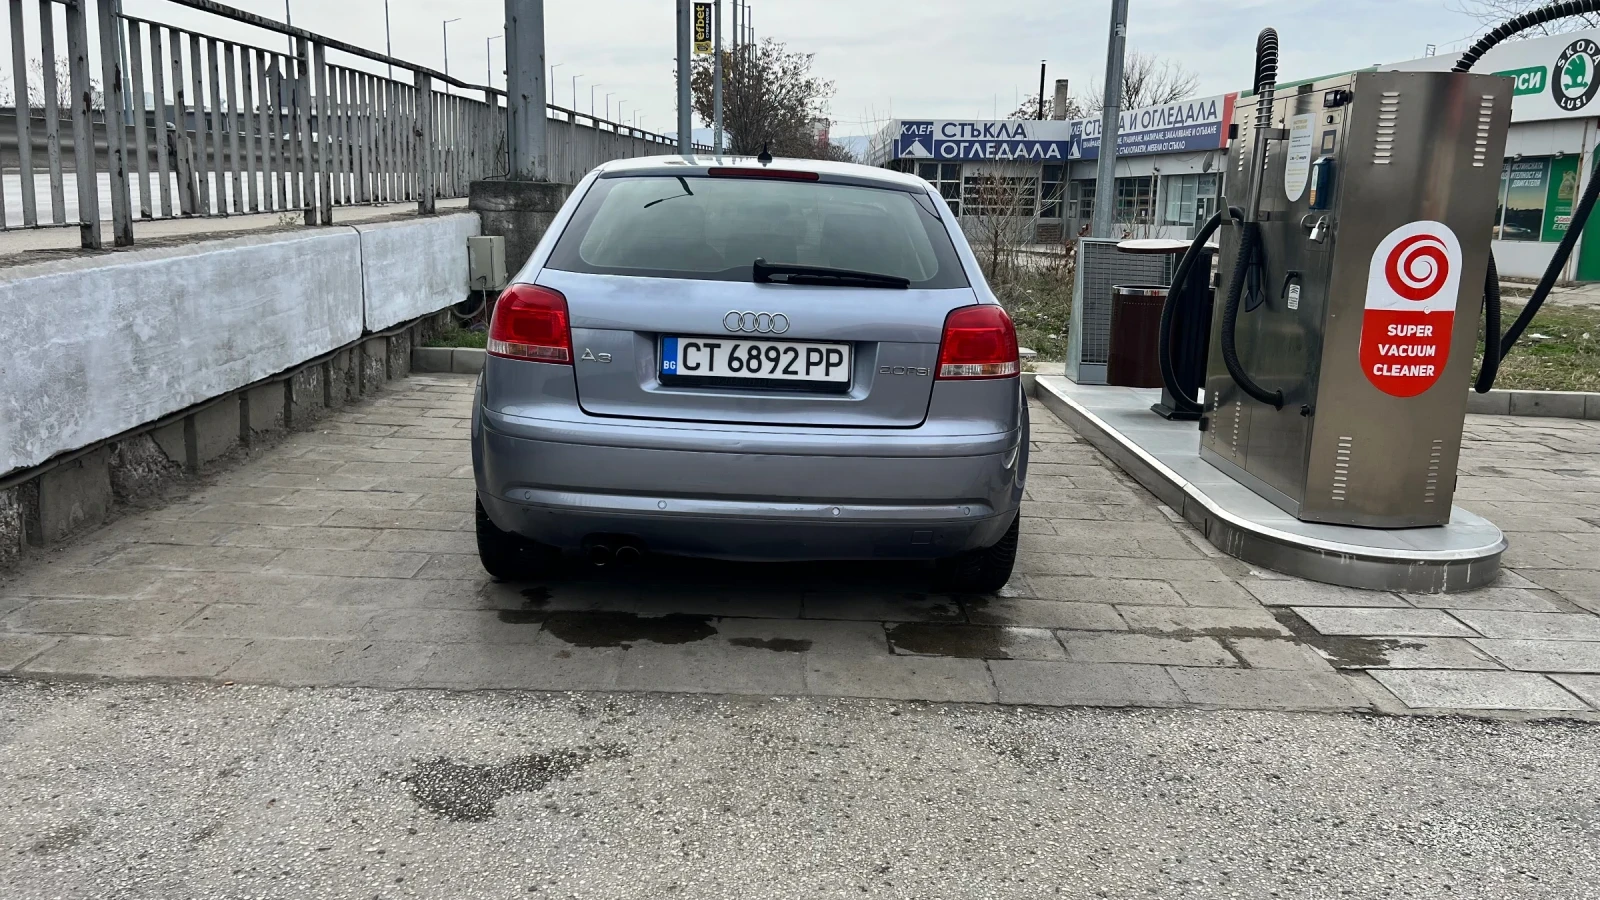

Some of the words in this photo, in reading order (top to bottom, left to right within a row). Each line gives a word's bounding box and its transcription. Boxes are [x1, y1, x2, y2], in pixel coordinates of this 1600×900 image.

[696, 5, 705, 40] efbet
[1560, 96, 1587, 109] LUSI
[1084, 116, 1126, 137] СТЪА
[1130, 112, 1138, 131] И
[1141, 99, 1218, 128] ОГЛЕДАЛА
[901, 124, 934, 135] КЛЕР
[941, 122, 1027, 139] СТЪКЛА
[940, 142, 1061, 160] ОГЛЕДАЛА
[1387, 324, 1433, 337] SUPER
[581, 347, 612, 363] A3
[1378, 344, 1436, 357] VACUUM
[663, 361, 676, 370] BG
[682, 342, 721, 372] CT
[728, 344, 799, 375] 6892
[805, 347, 844, 377] PP
[879, 365, 905, 375] 2.0
[1373, 363, 1435, 377] CLEANER
